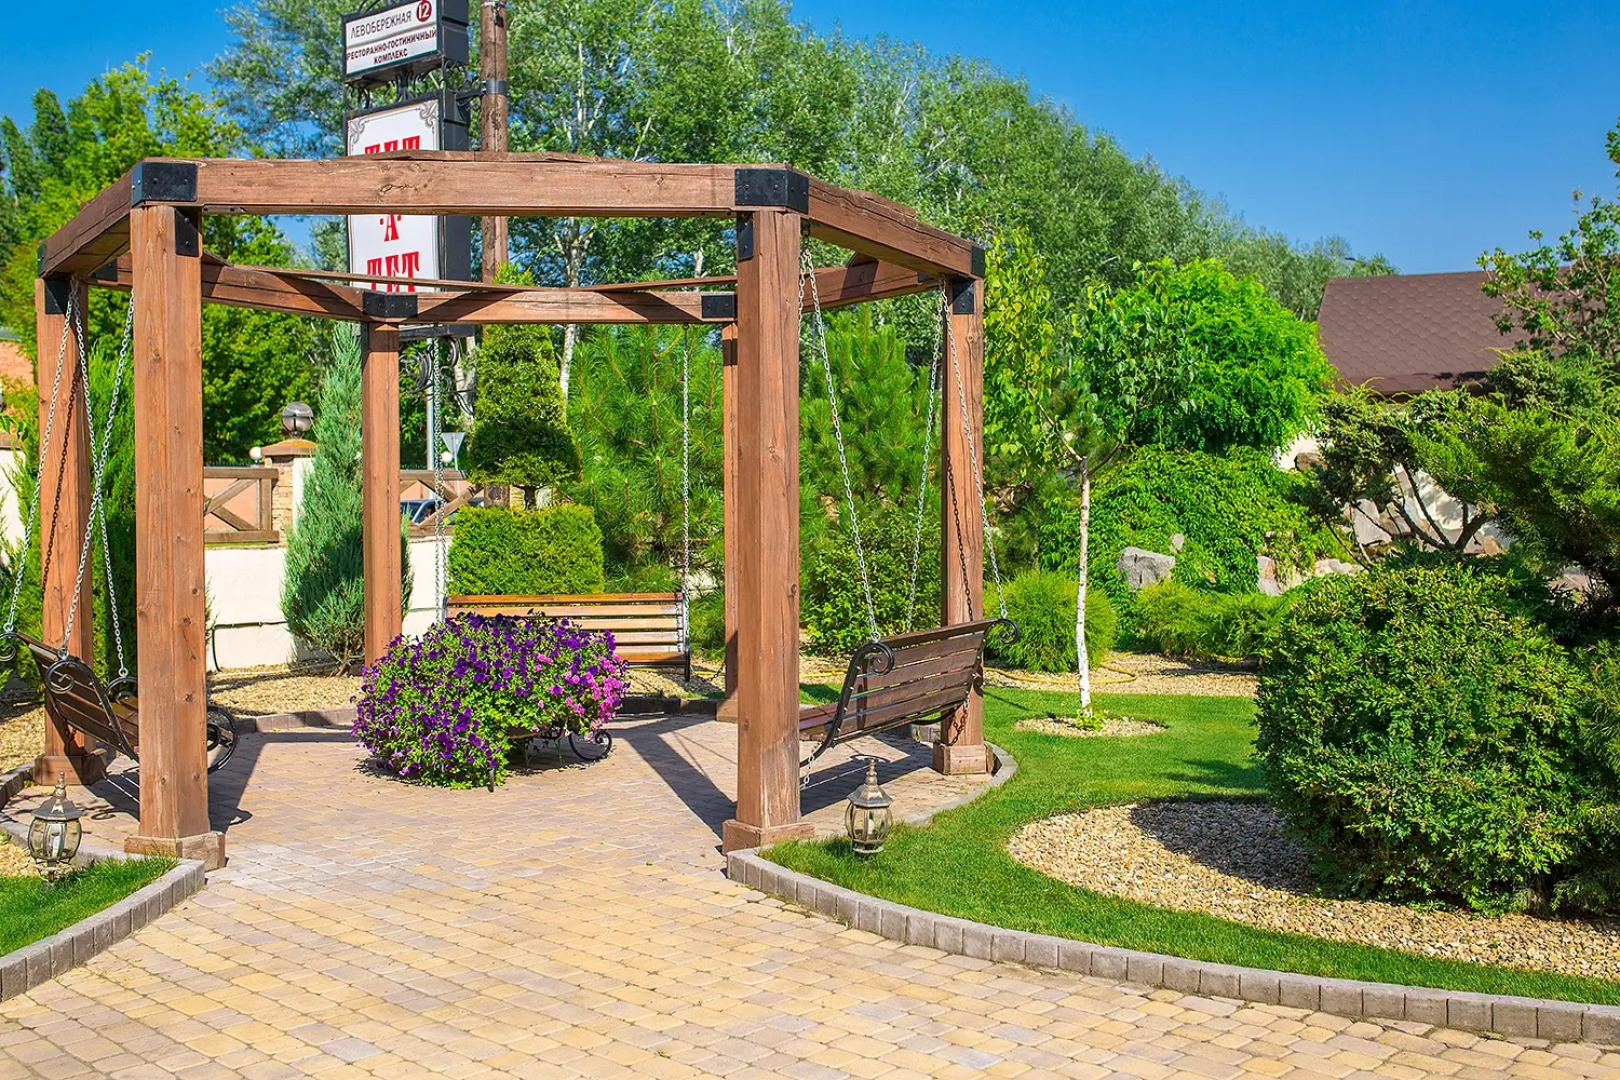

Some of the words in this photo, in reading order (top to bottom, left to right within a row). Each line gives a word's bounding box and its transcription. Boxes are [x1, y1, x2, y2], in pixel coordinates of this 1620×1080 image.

[350, 11, 412, 39] ЛЕВОБЕРЕЖНАЯ
[418, 2, 430, 20] 12
[346, 27, 437, 60] РЕСТОРАННО-ГОСТИНИЧНЫЙ
[373, 48, 408, 65] КОМПЛЕКС
